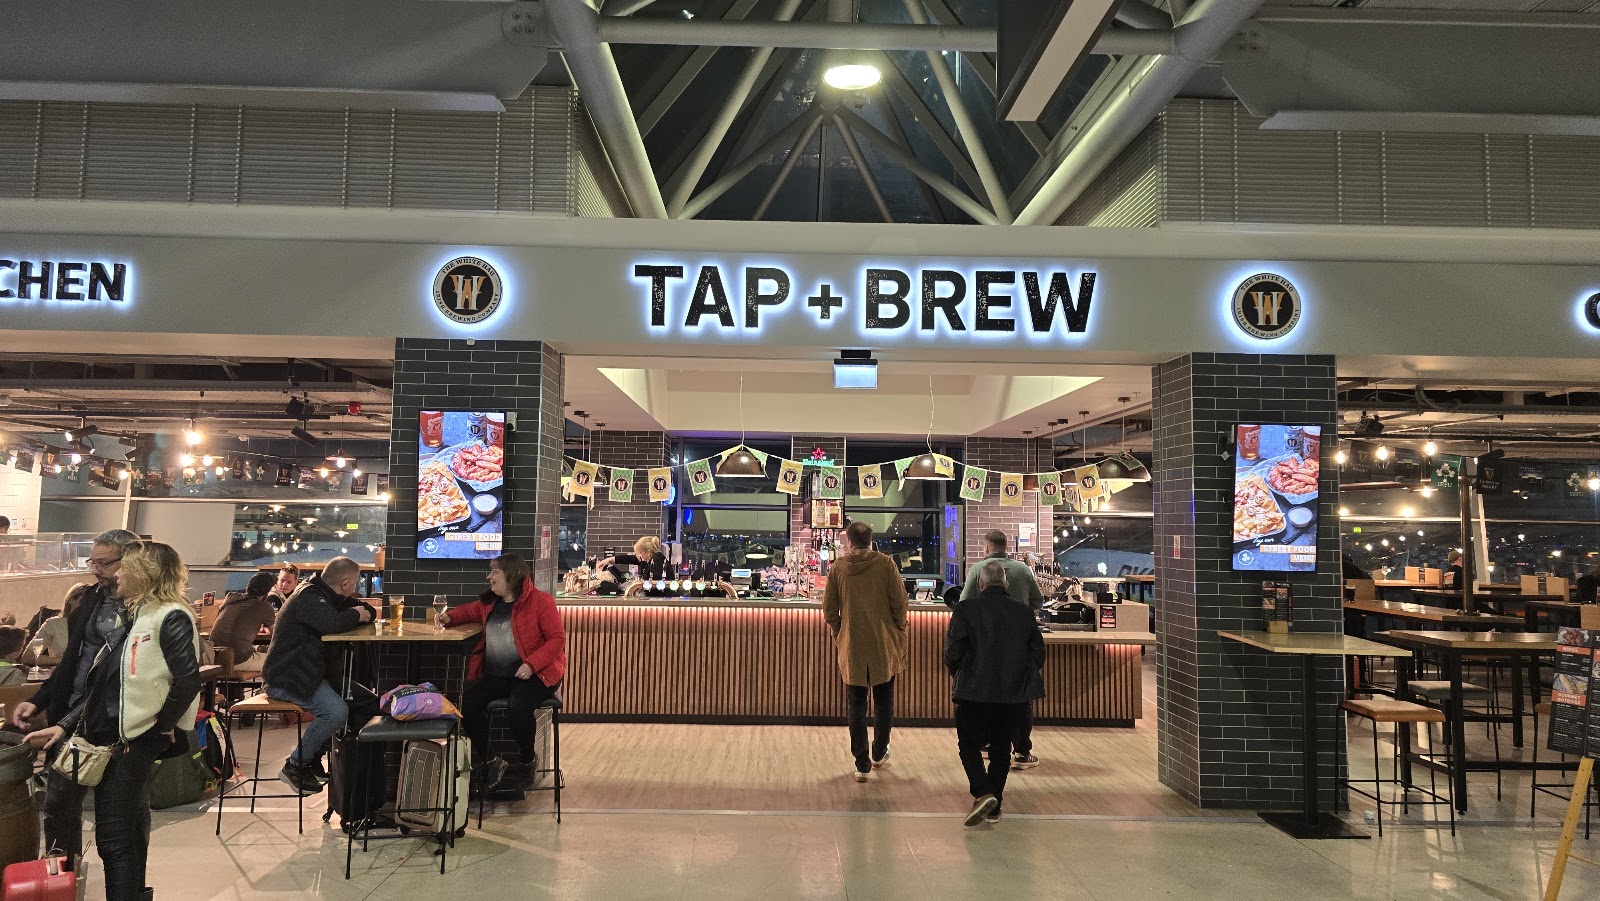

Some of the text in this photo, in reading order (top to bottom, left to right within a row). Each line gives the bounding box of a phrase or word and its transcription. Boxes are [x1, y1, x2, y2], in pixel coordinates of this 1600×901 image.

[441, 262, 456, 274] THE
[1241, 280, 1254, 291] THE
[1254, 274, 1280, 282] WHITE
[634, 265, 791, 328] TAP
[865, 268, 1097, 333] BREW
[1294, 545, 1316, 553] FOOD
